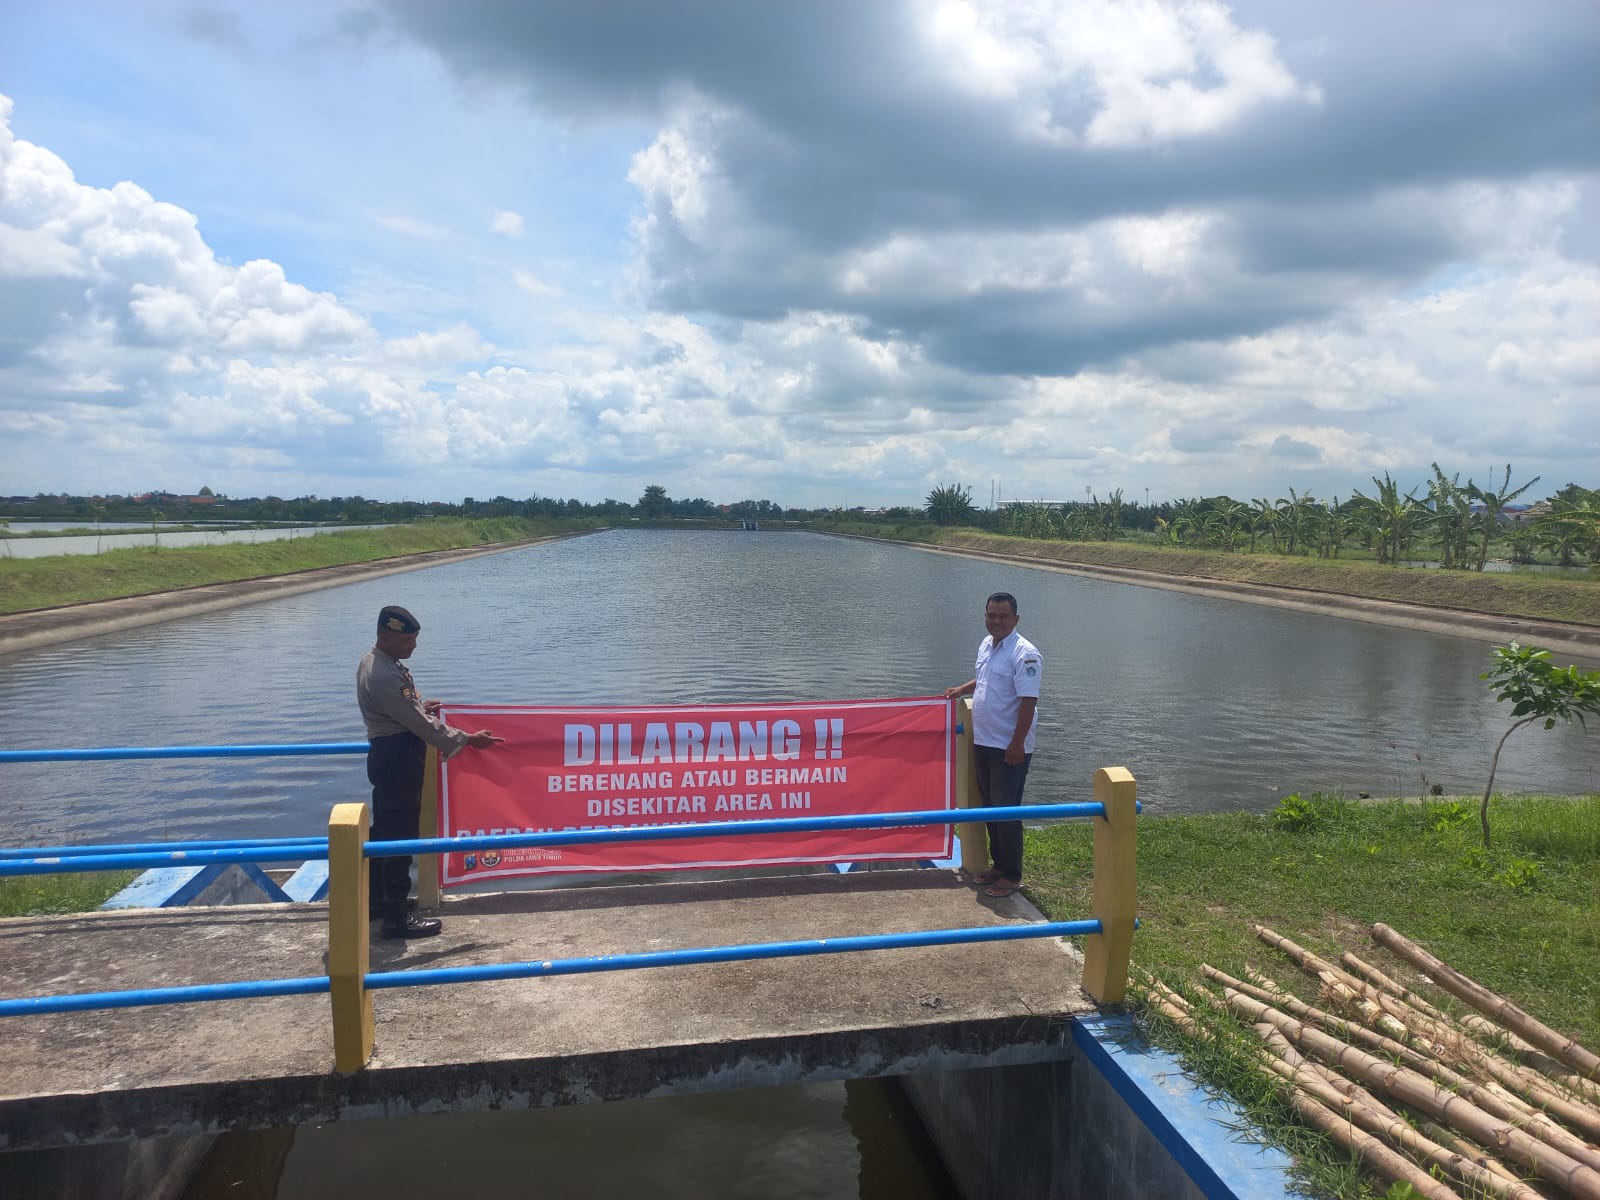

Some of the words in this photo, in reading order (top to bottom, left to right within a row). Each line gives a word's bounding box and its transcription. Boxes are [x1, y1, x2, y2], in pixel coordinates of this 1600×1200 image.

[564, 719, 801, 767] DILARANG
[814, 718, 844, 760] !!
[547, 771, 673, 793] BERENANG
[680, 769, 737, 788] ATAU
[745, 766, 847, 786] BERMAIN
[587, 795, 707, 817] DISEKITAR
[714, 793, 773, 812] AREA
[781, 791, 811, 809] INI
